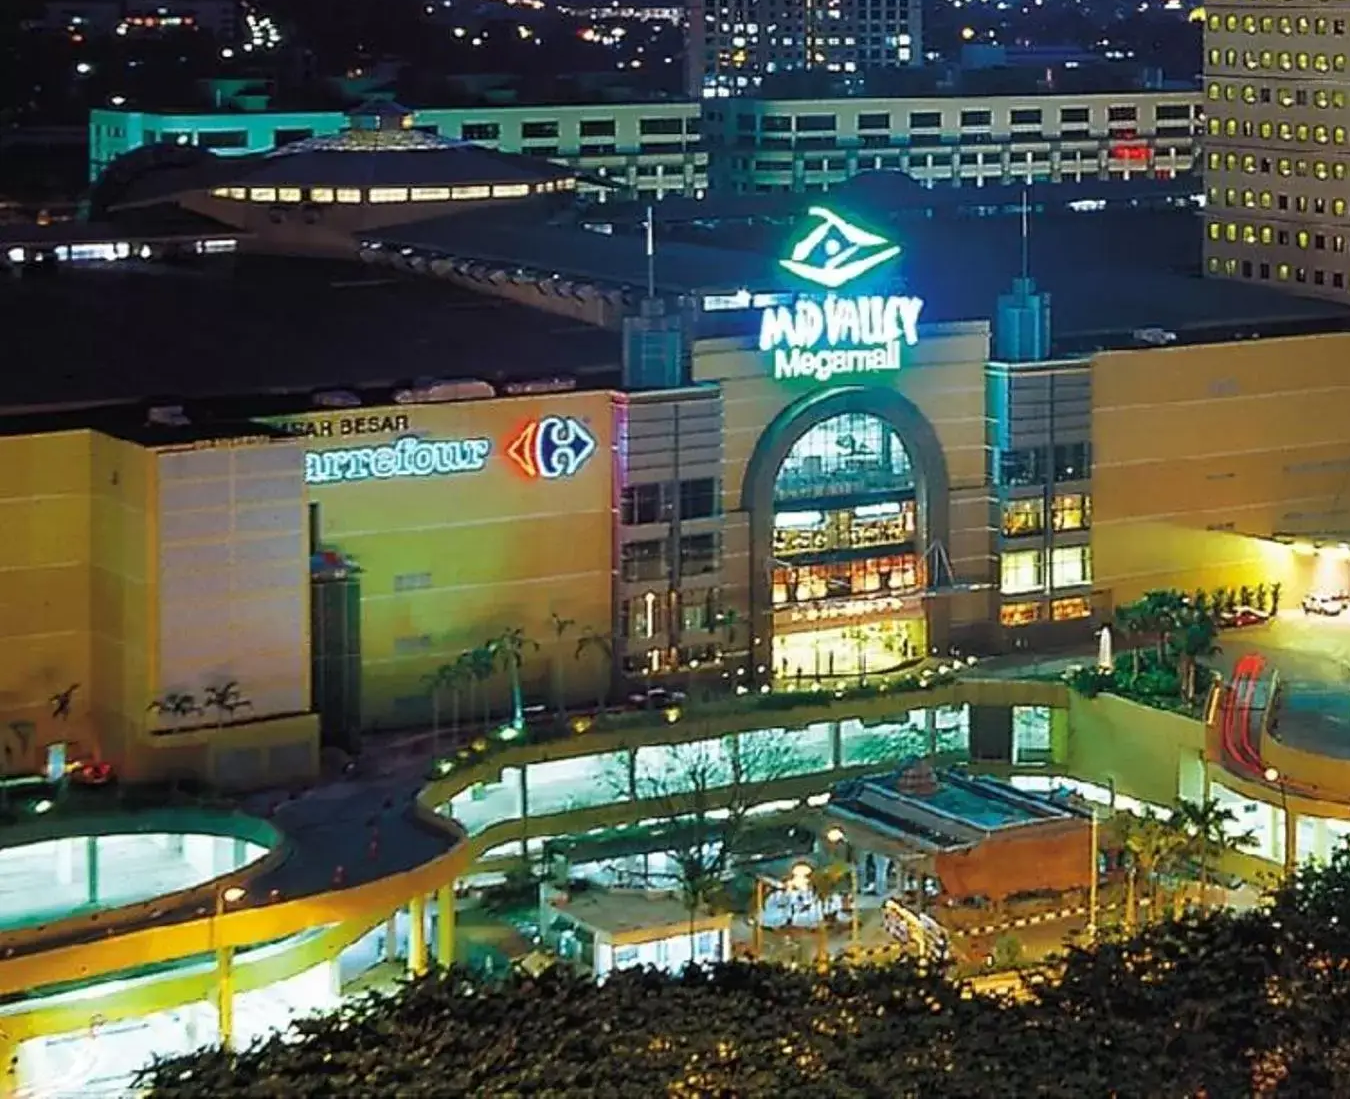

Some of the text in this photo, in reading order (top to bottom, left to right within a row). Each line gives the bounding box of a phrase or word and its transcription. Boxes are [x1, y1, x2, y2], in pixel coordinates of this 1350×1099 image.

[823, 294, 925, 347] VALLEY
[774, 340, 901, 381] Megamall
[341, 415, 409, 435] BESAR
